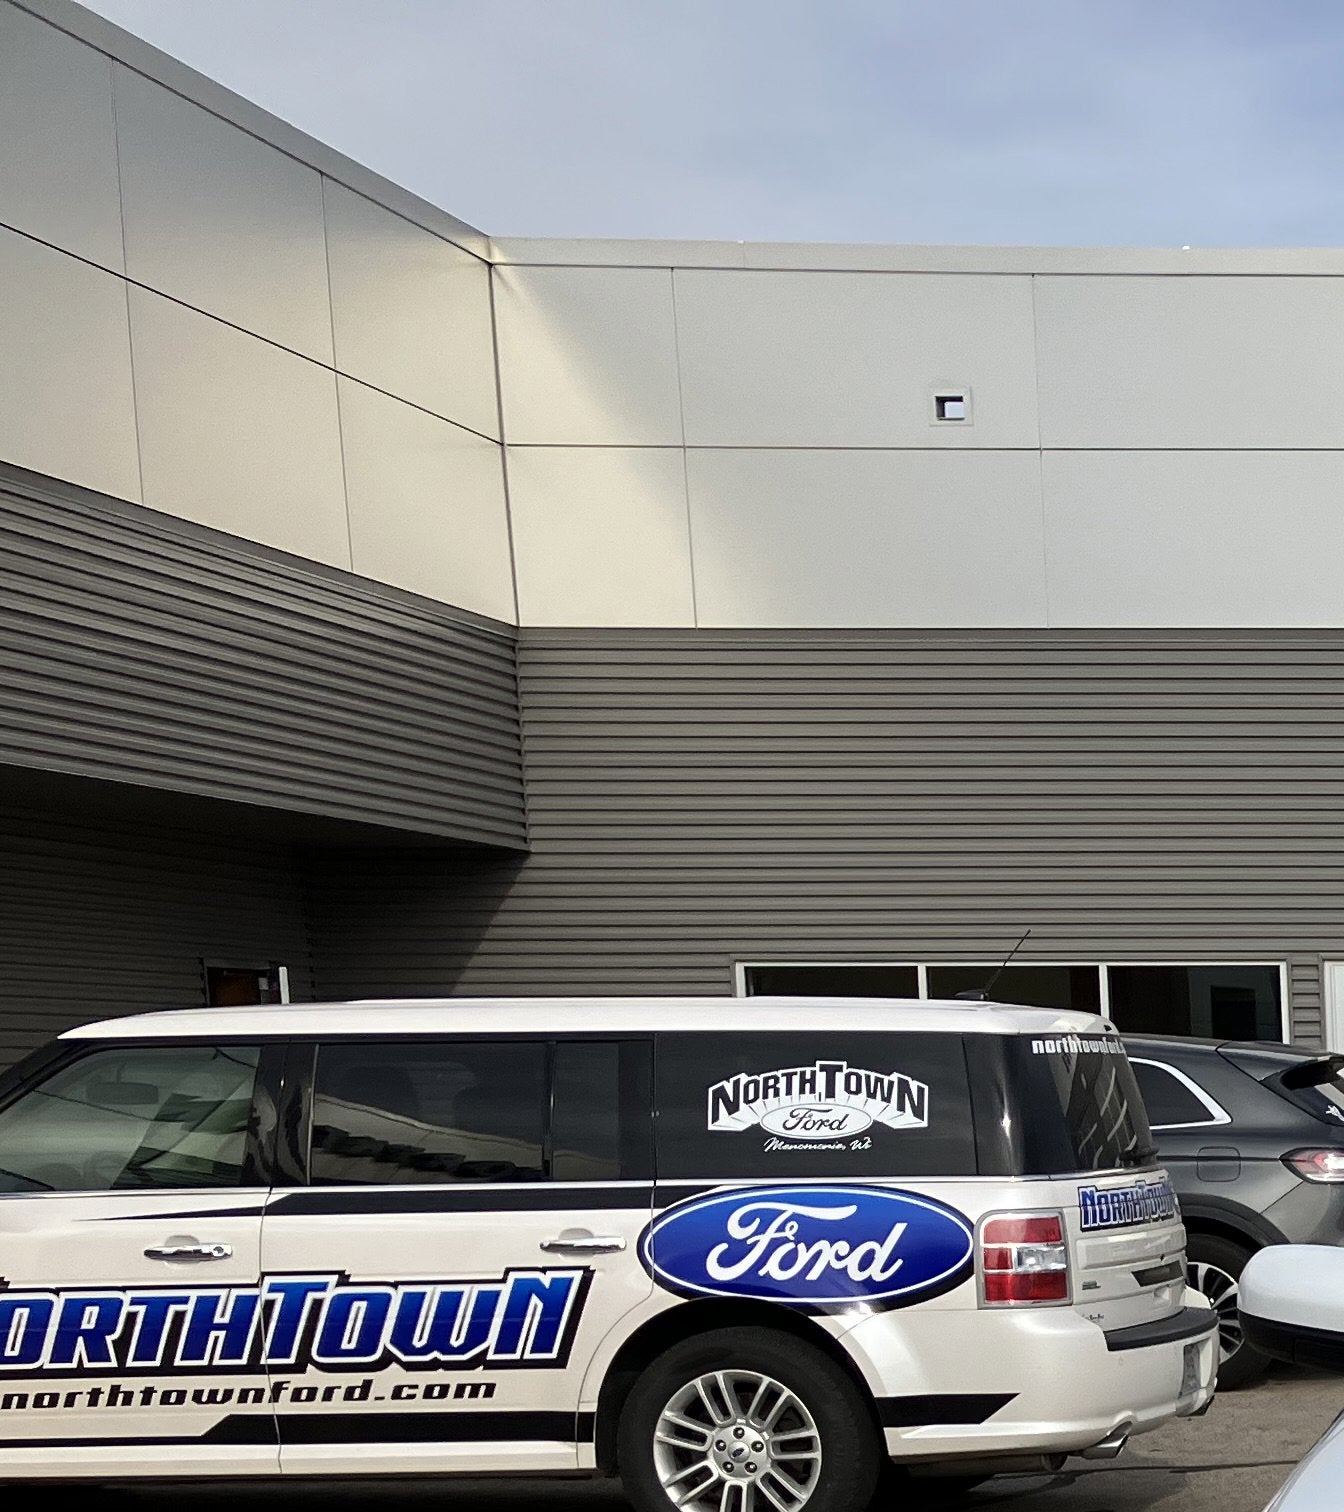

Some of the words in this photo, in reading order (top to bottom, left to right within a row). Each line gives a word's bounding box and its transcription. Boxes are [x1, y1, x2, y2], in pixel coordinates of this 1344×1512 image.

[782, 1107, 849, 1132] Ford
[705, 1201, 908, 1283] Ford
[0, 1268, 590, 1374] ORTHTOWN
[1, 1378, 497, 1410] northtownford.com
